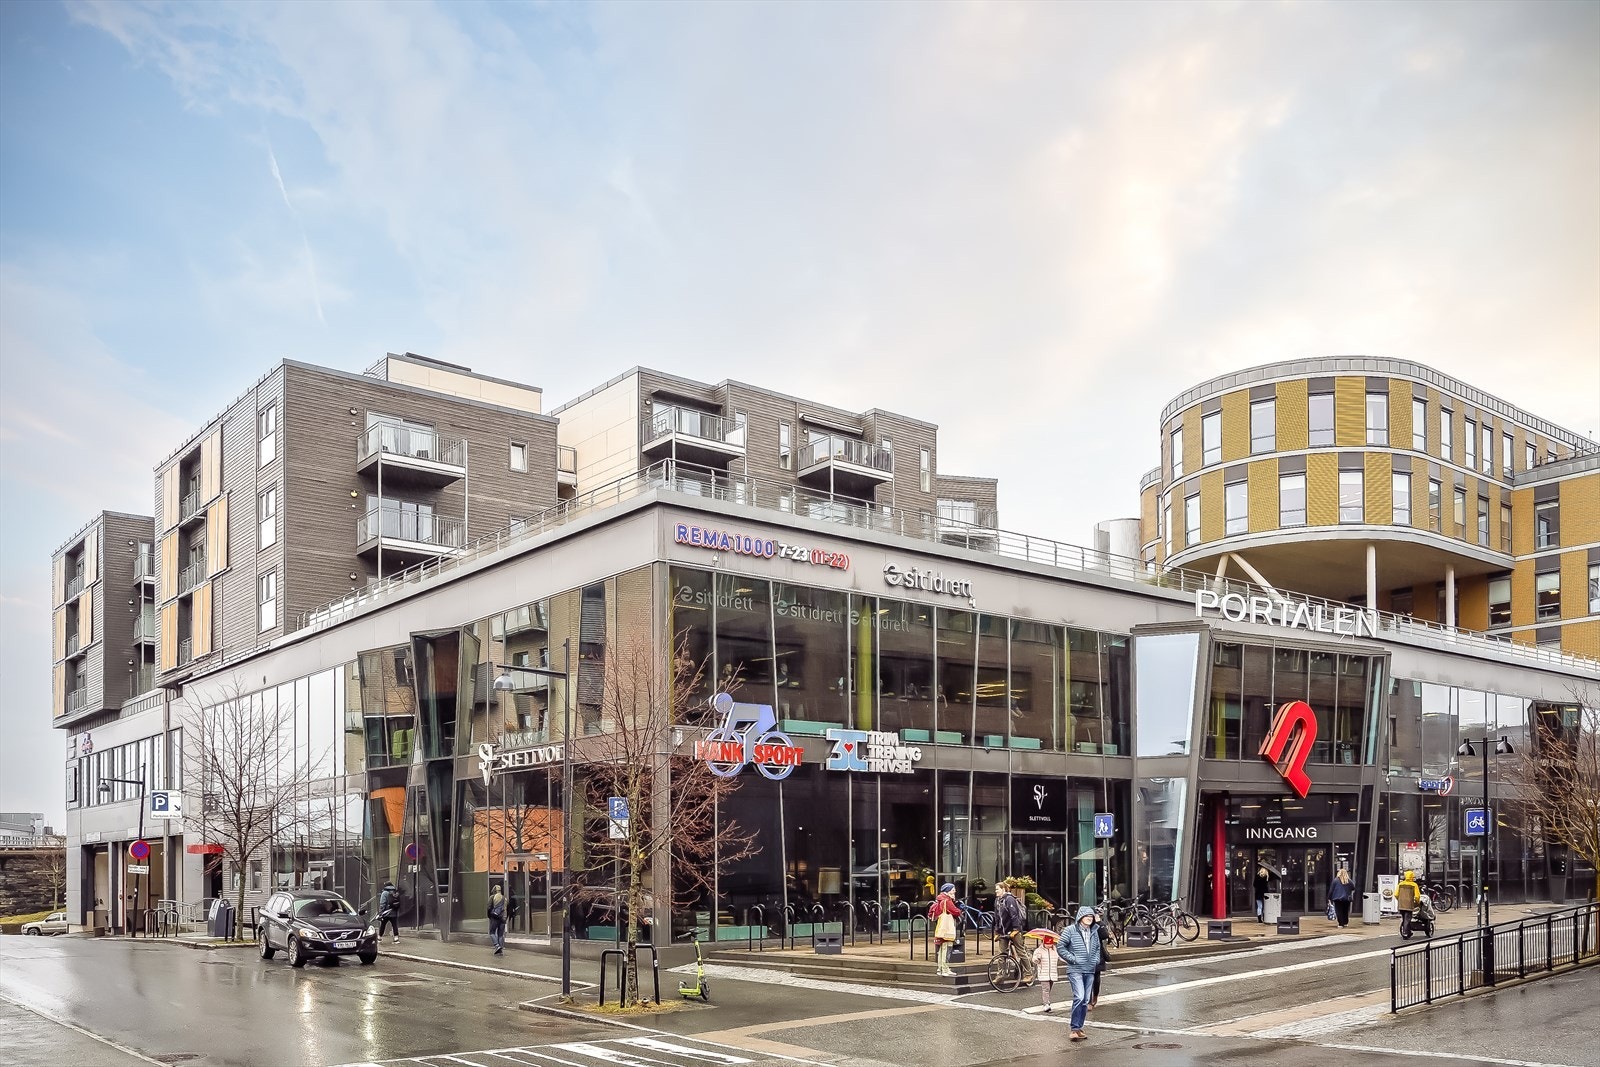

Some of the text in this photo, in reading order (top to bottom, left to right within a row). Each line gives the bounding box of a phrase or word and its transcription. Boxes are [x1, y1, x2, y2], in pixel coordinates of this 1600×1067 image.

[675, 523, 850, 571] REMA 1000 7-23 (11-22)
[904, 567, 973, 597] sit idrett
[696, 588, 753, 611] sit idrett
[790, 604, 843, 624] sit idrett
[1195, 589, 1377, 638] PORTALEN
[868, 731, 899, 746] TRIM
[501, 744, 571, 769] SLETTVOL
[695, 741, 804, 766] HANK SPORT
[867, 744, 922, 761] TRENING
[868, 758, 914, 774] TRIVSEL
[155, 797, 166, 810] P
[1246, 827, 1317, 839] INNGANG
